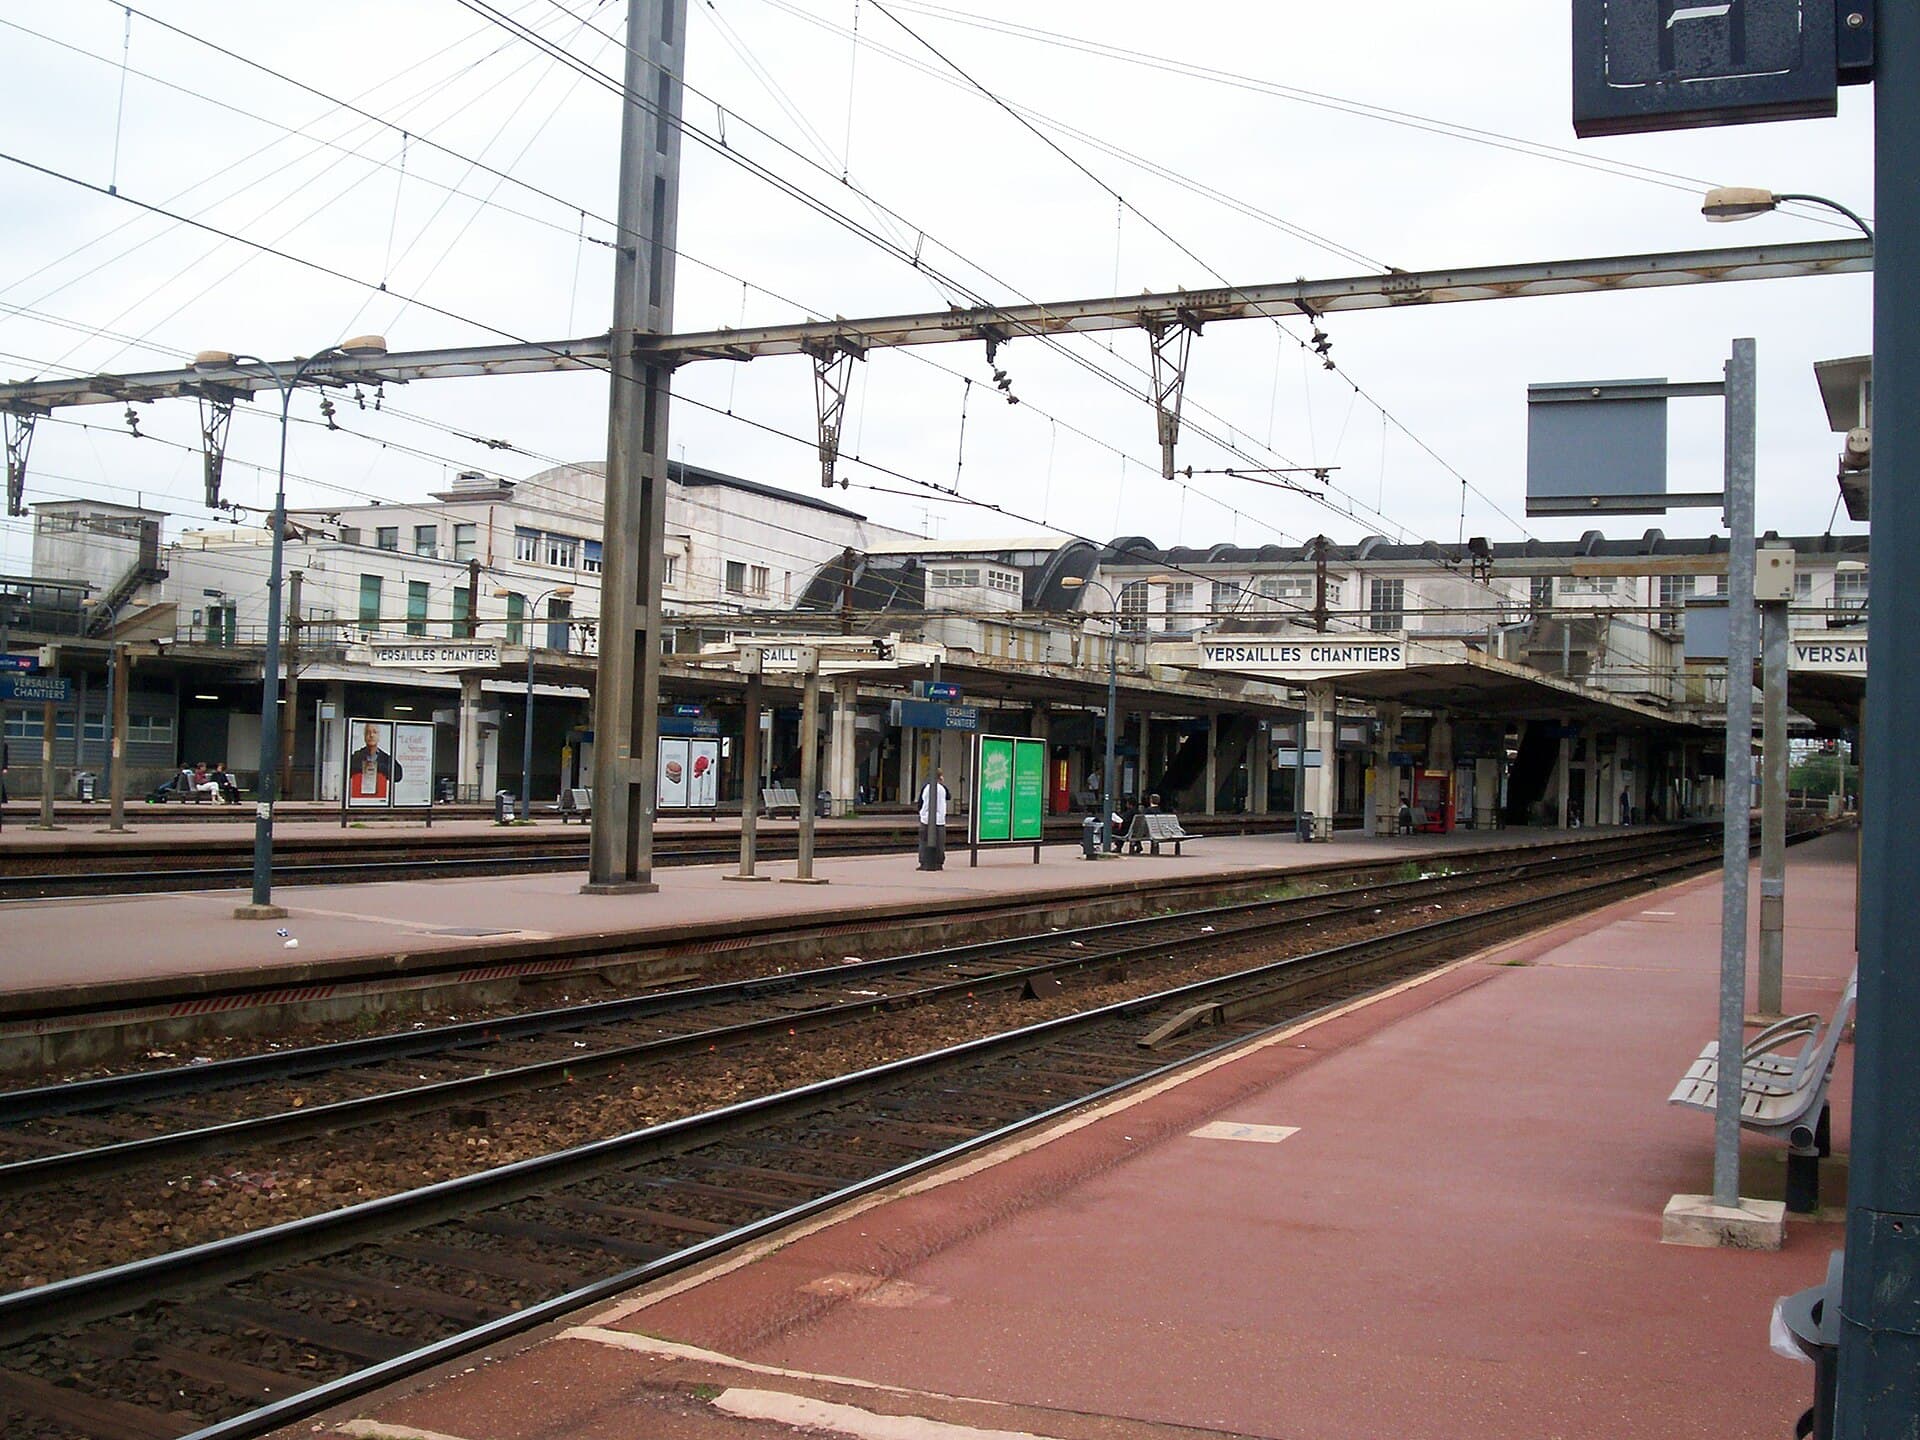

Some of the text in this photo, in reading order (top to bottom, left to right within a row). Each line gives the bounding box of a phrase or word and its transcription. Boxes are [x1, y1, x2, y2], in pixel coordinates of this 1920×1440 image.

[375, 649, 497, 661] VERSAILLES CHANTIERS
[763, 648, 797, 661] SAILL
[1205, 647, 1401, 662] VERSAILLES CHANTIERS
[1797, 646, 1867, 663] VERSAI
[14, 678, 65, 689] VERSAILLES
[13, 687, 65, 700] CHANTIERS
